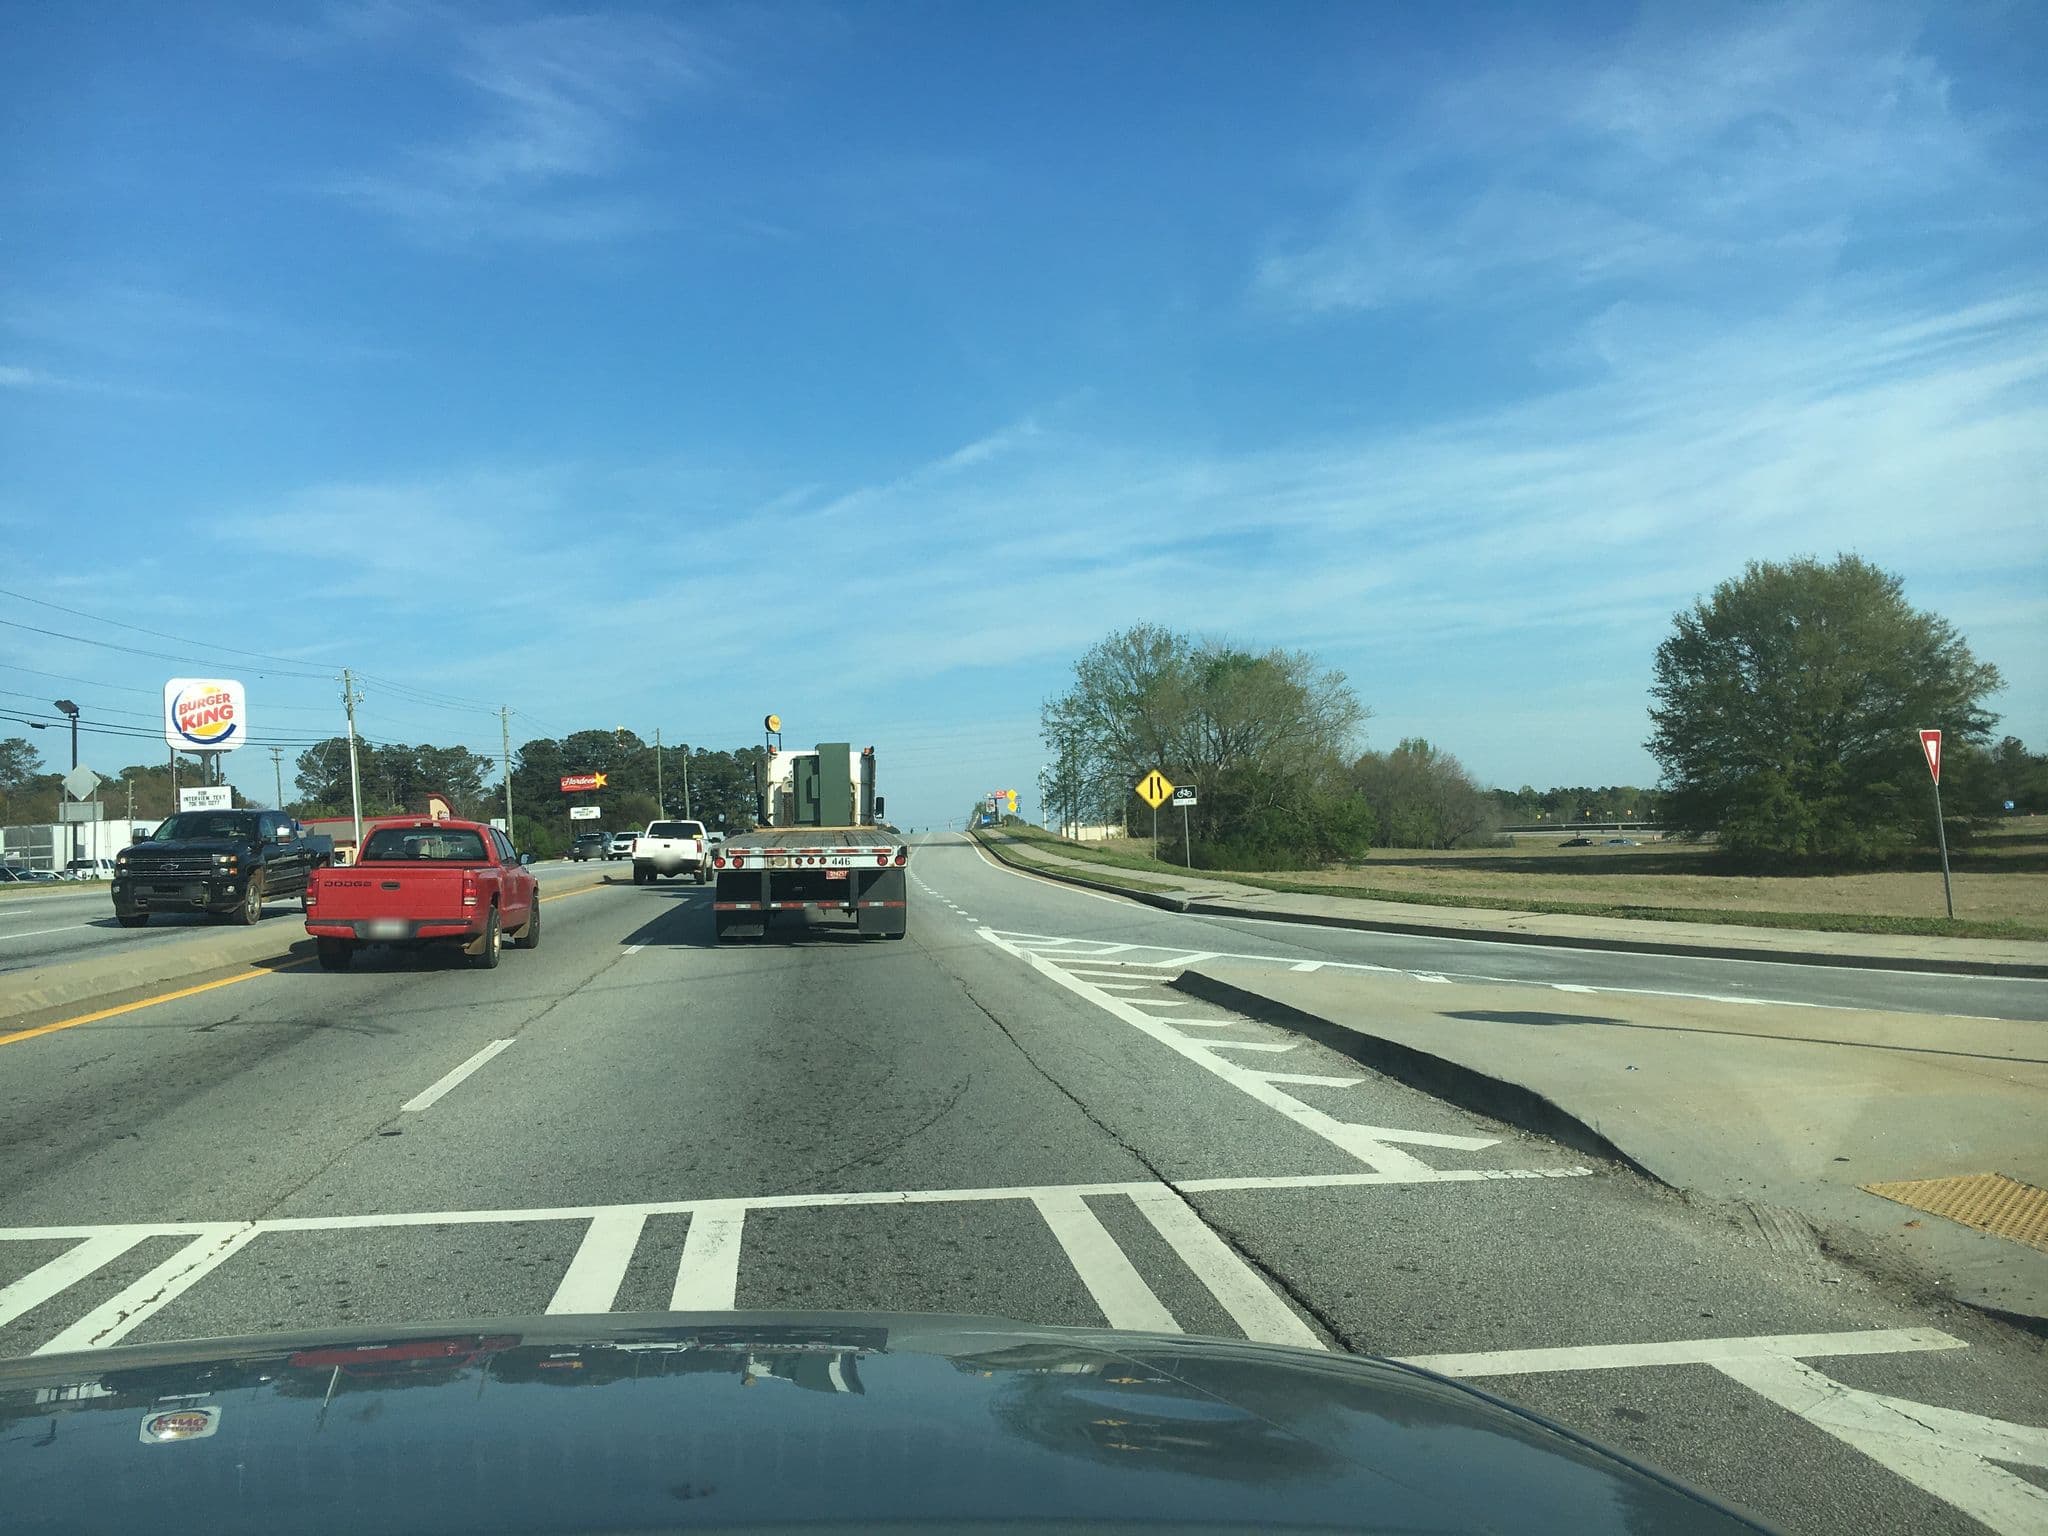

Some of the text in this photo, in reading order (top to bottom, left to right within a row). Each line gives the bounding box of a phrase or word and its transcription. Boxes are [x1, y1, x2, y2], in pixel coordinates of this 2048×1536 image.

[179, 693, 231, 715] BURGER
[181, 704, 234, 732] KING
[832, 857, 850, 866] 446
